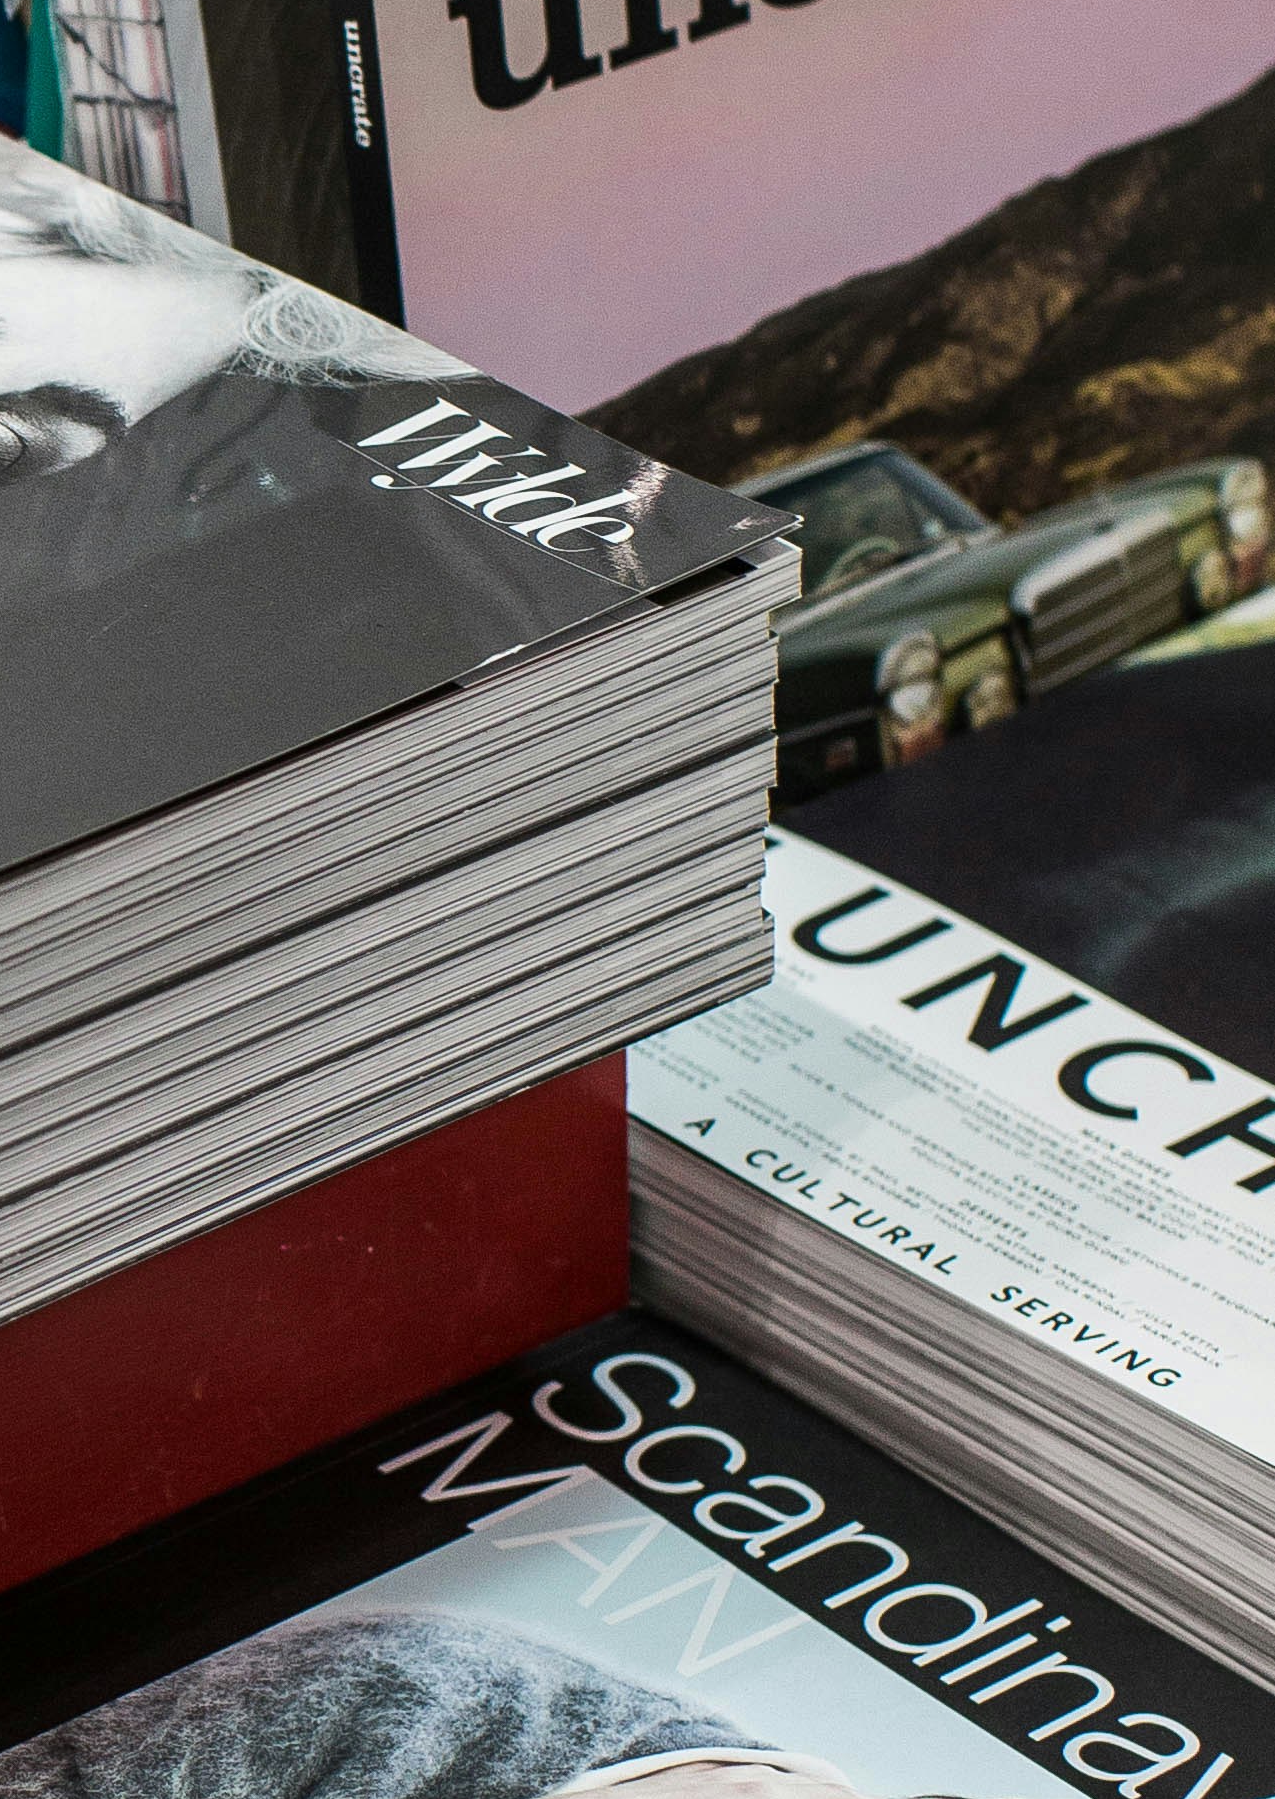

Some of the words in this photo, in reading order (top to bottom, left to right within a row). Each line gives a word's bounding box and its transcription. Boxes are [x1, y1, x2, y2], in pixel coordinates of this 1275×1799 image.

[343, 19, 374, 150] uncrate
[357, 396, 636, 554] Wylde
[764, 834, 1275, 1197] UNCH
[683, 1117, 717, 1139] A
[745, 1147, 961, 1277] CULTURAL
[990, 1284, 1184, 1389] SERVING
[378, 1410, 812, 1680] MAN
